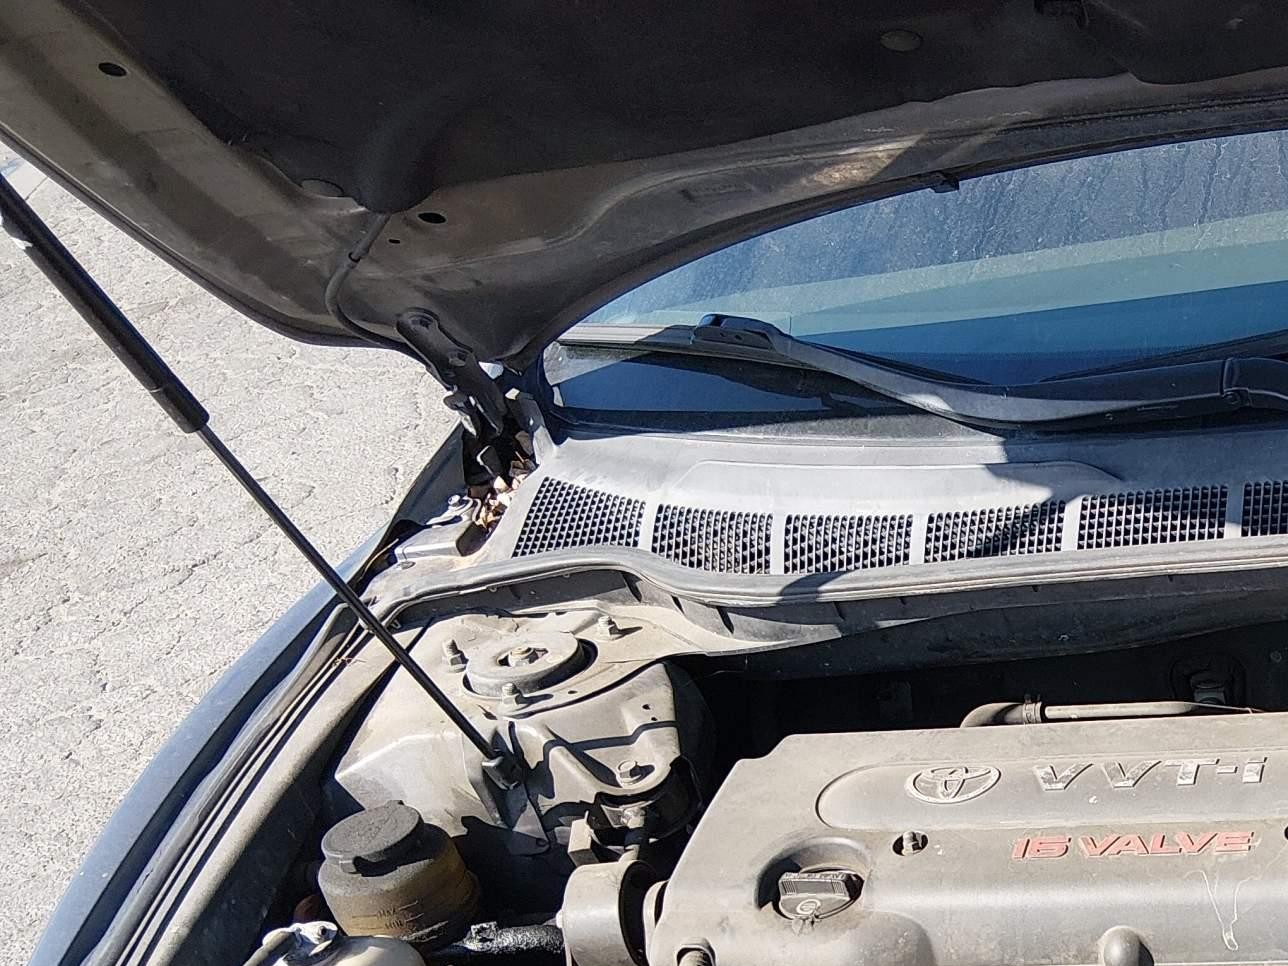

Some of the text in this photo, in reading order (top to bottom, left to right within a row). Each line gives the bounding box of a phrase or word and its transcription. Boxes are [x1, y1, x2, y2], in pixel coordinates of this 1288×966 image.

[1034, 757, 1267, 791] VVT-i
[1012, 831, 1256, 859] 16 VALVE
